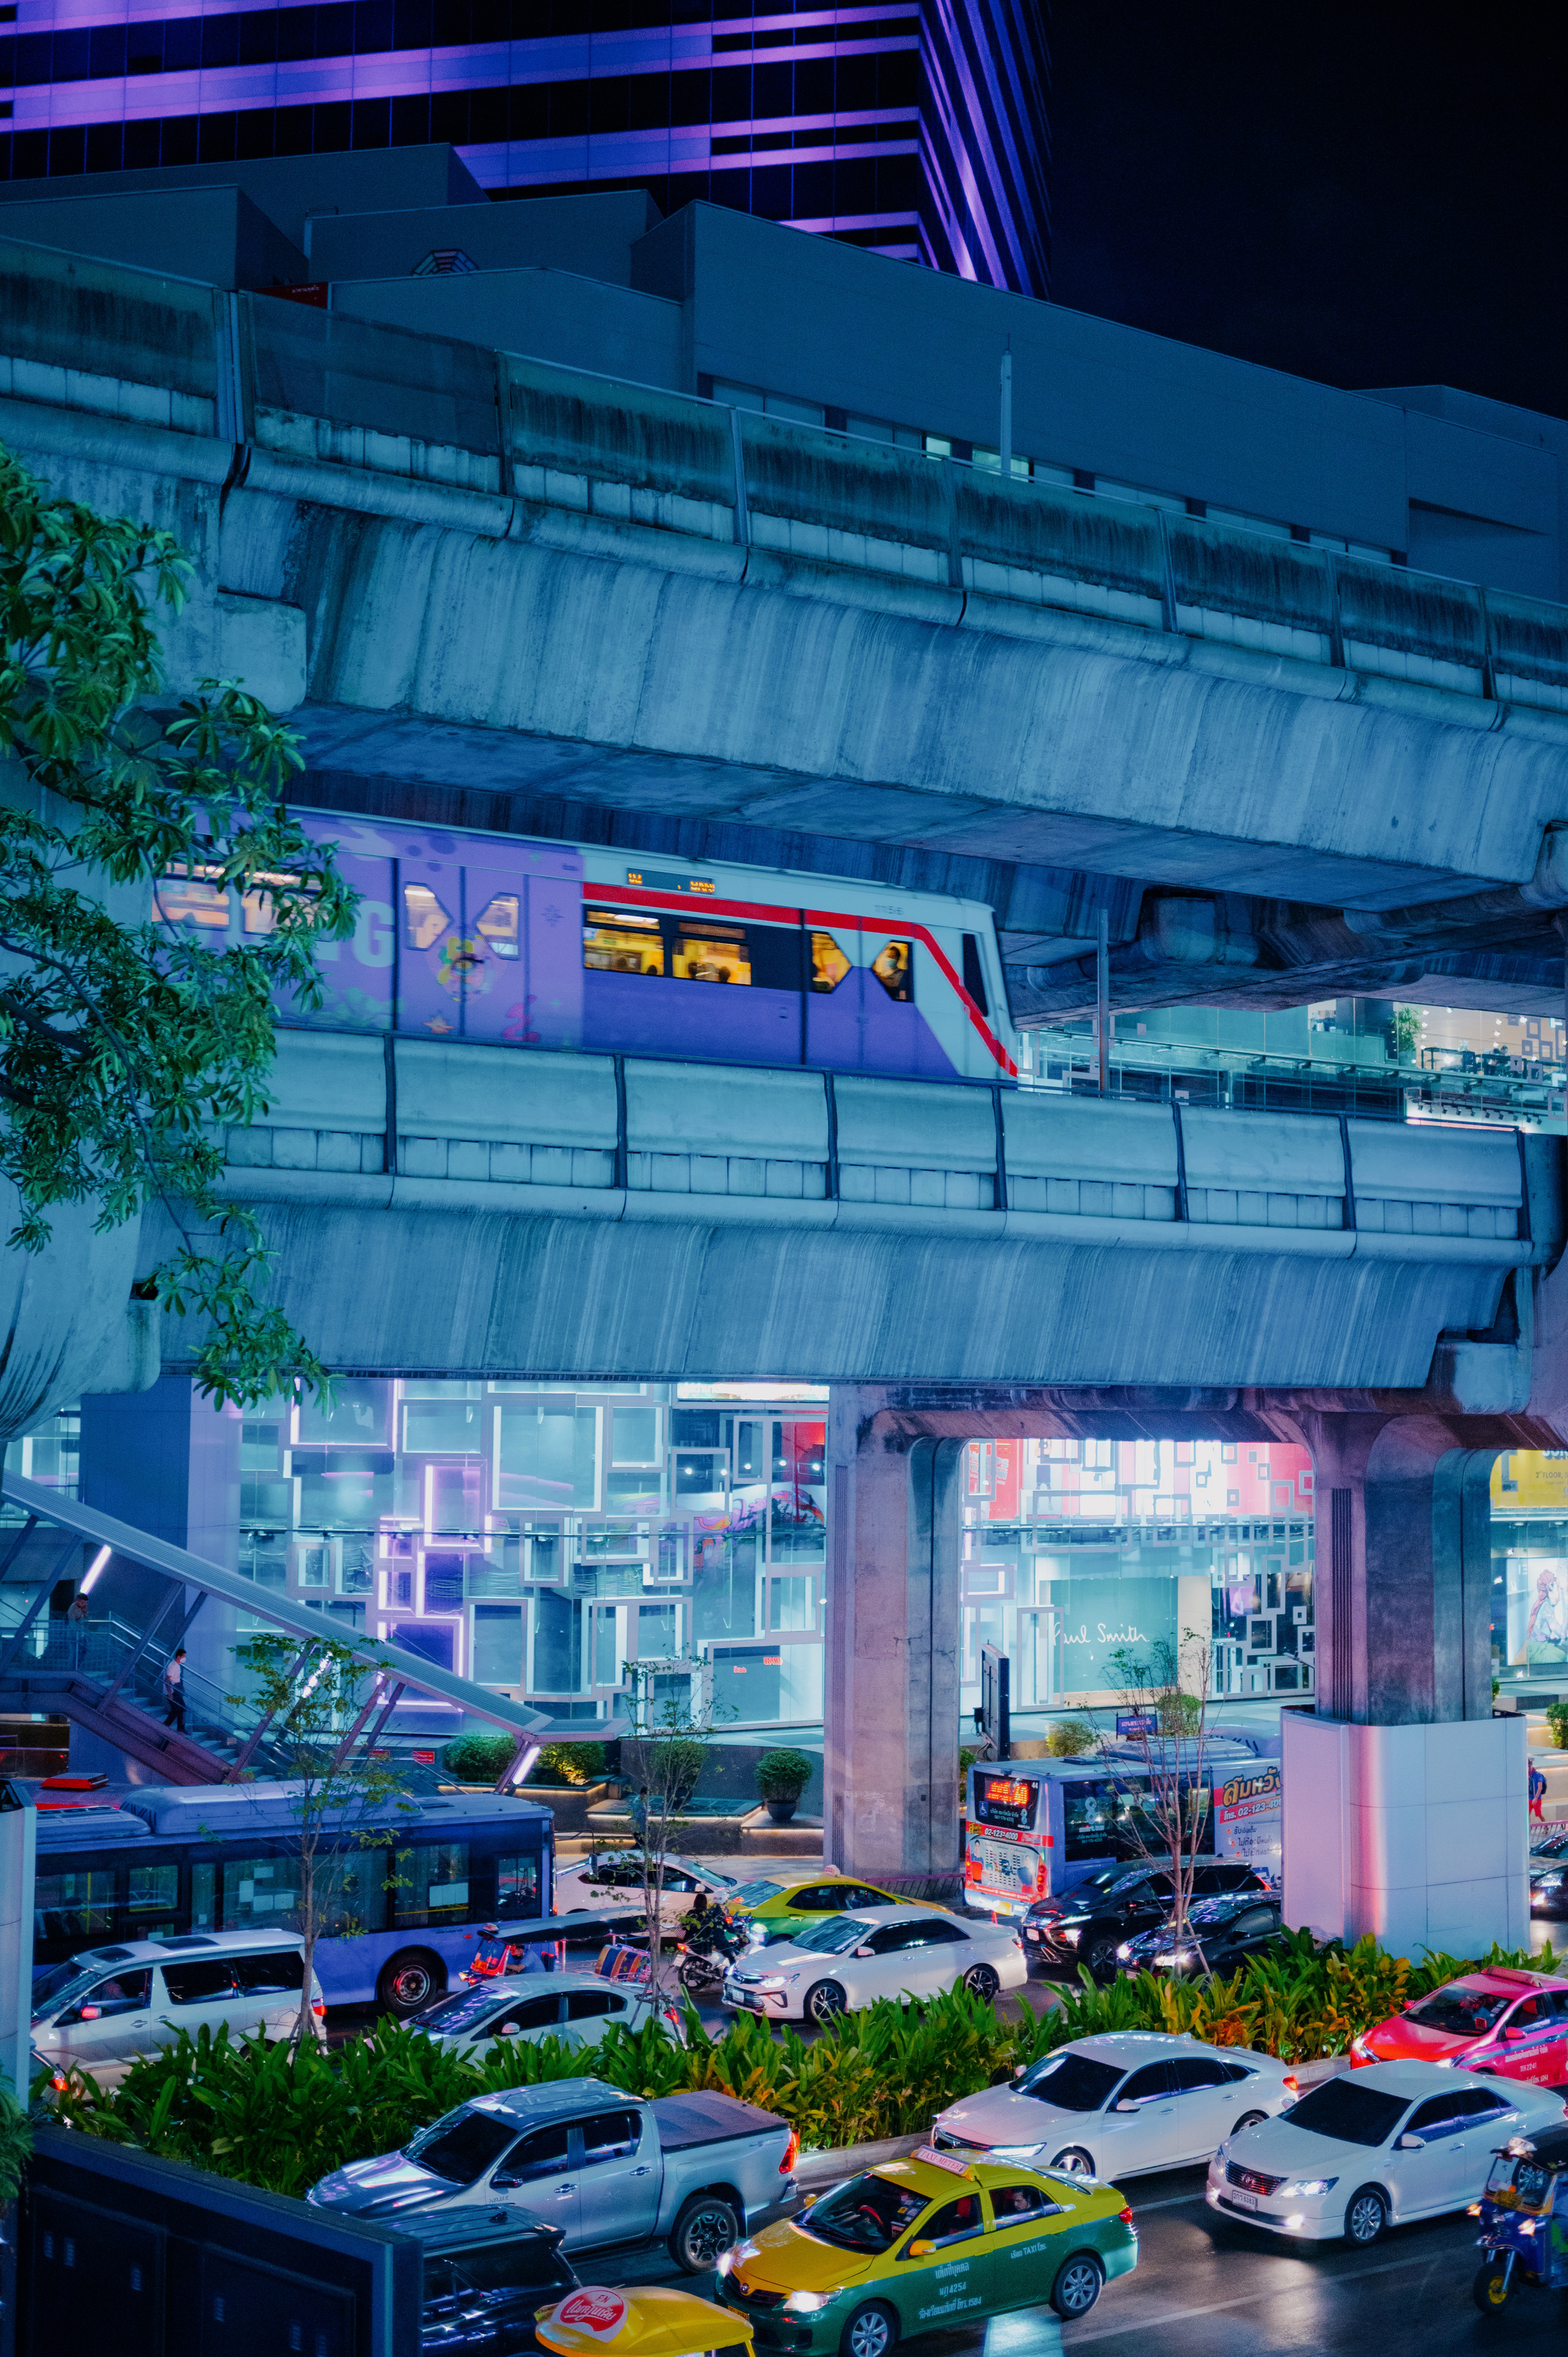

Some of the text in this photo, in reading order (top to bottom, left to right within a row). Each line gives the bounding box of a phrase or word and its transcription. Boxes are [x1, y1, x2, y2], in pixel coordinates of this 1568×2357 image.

[1097, 1623, 1150, 1643] Smith
[984, 1827, 1019, 1841] 02-123-4000
[1023, 2244, 1037, 2255] TAXI
[949, 2281, 967, 2293] 4254
